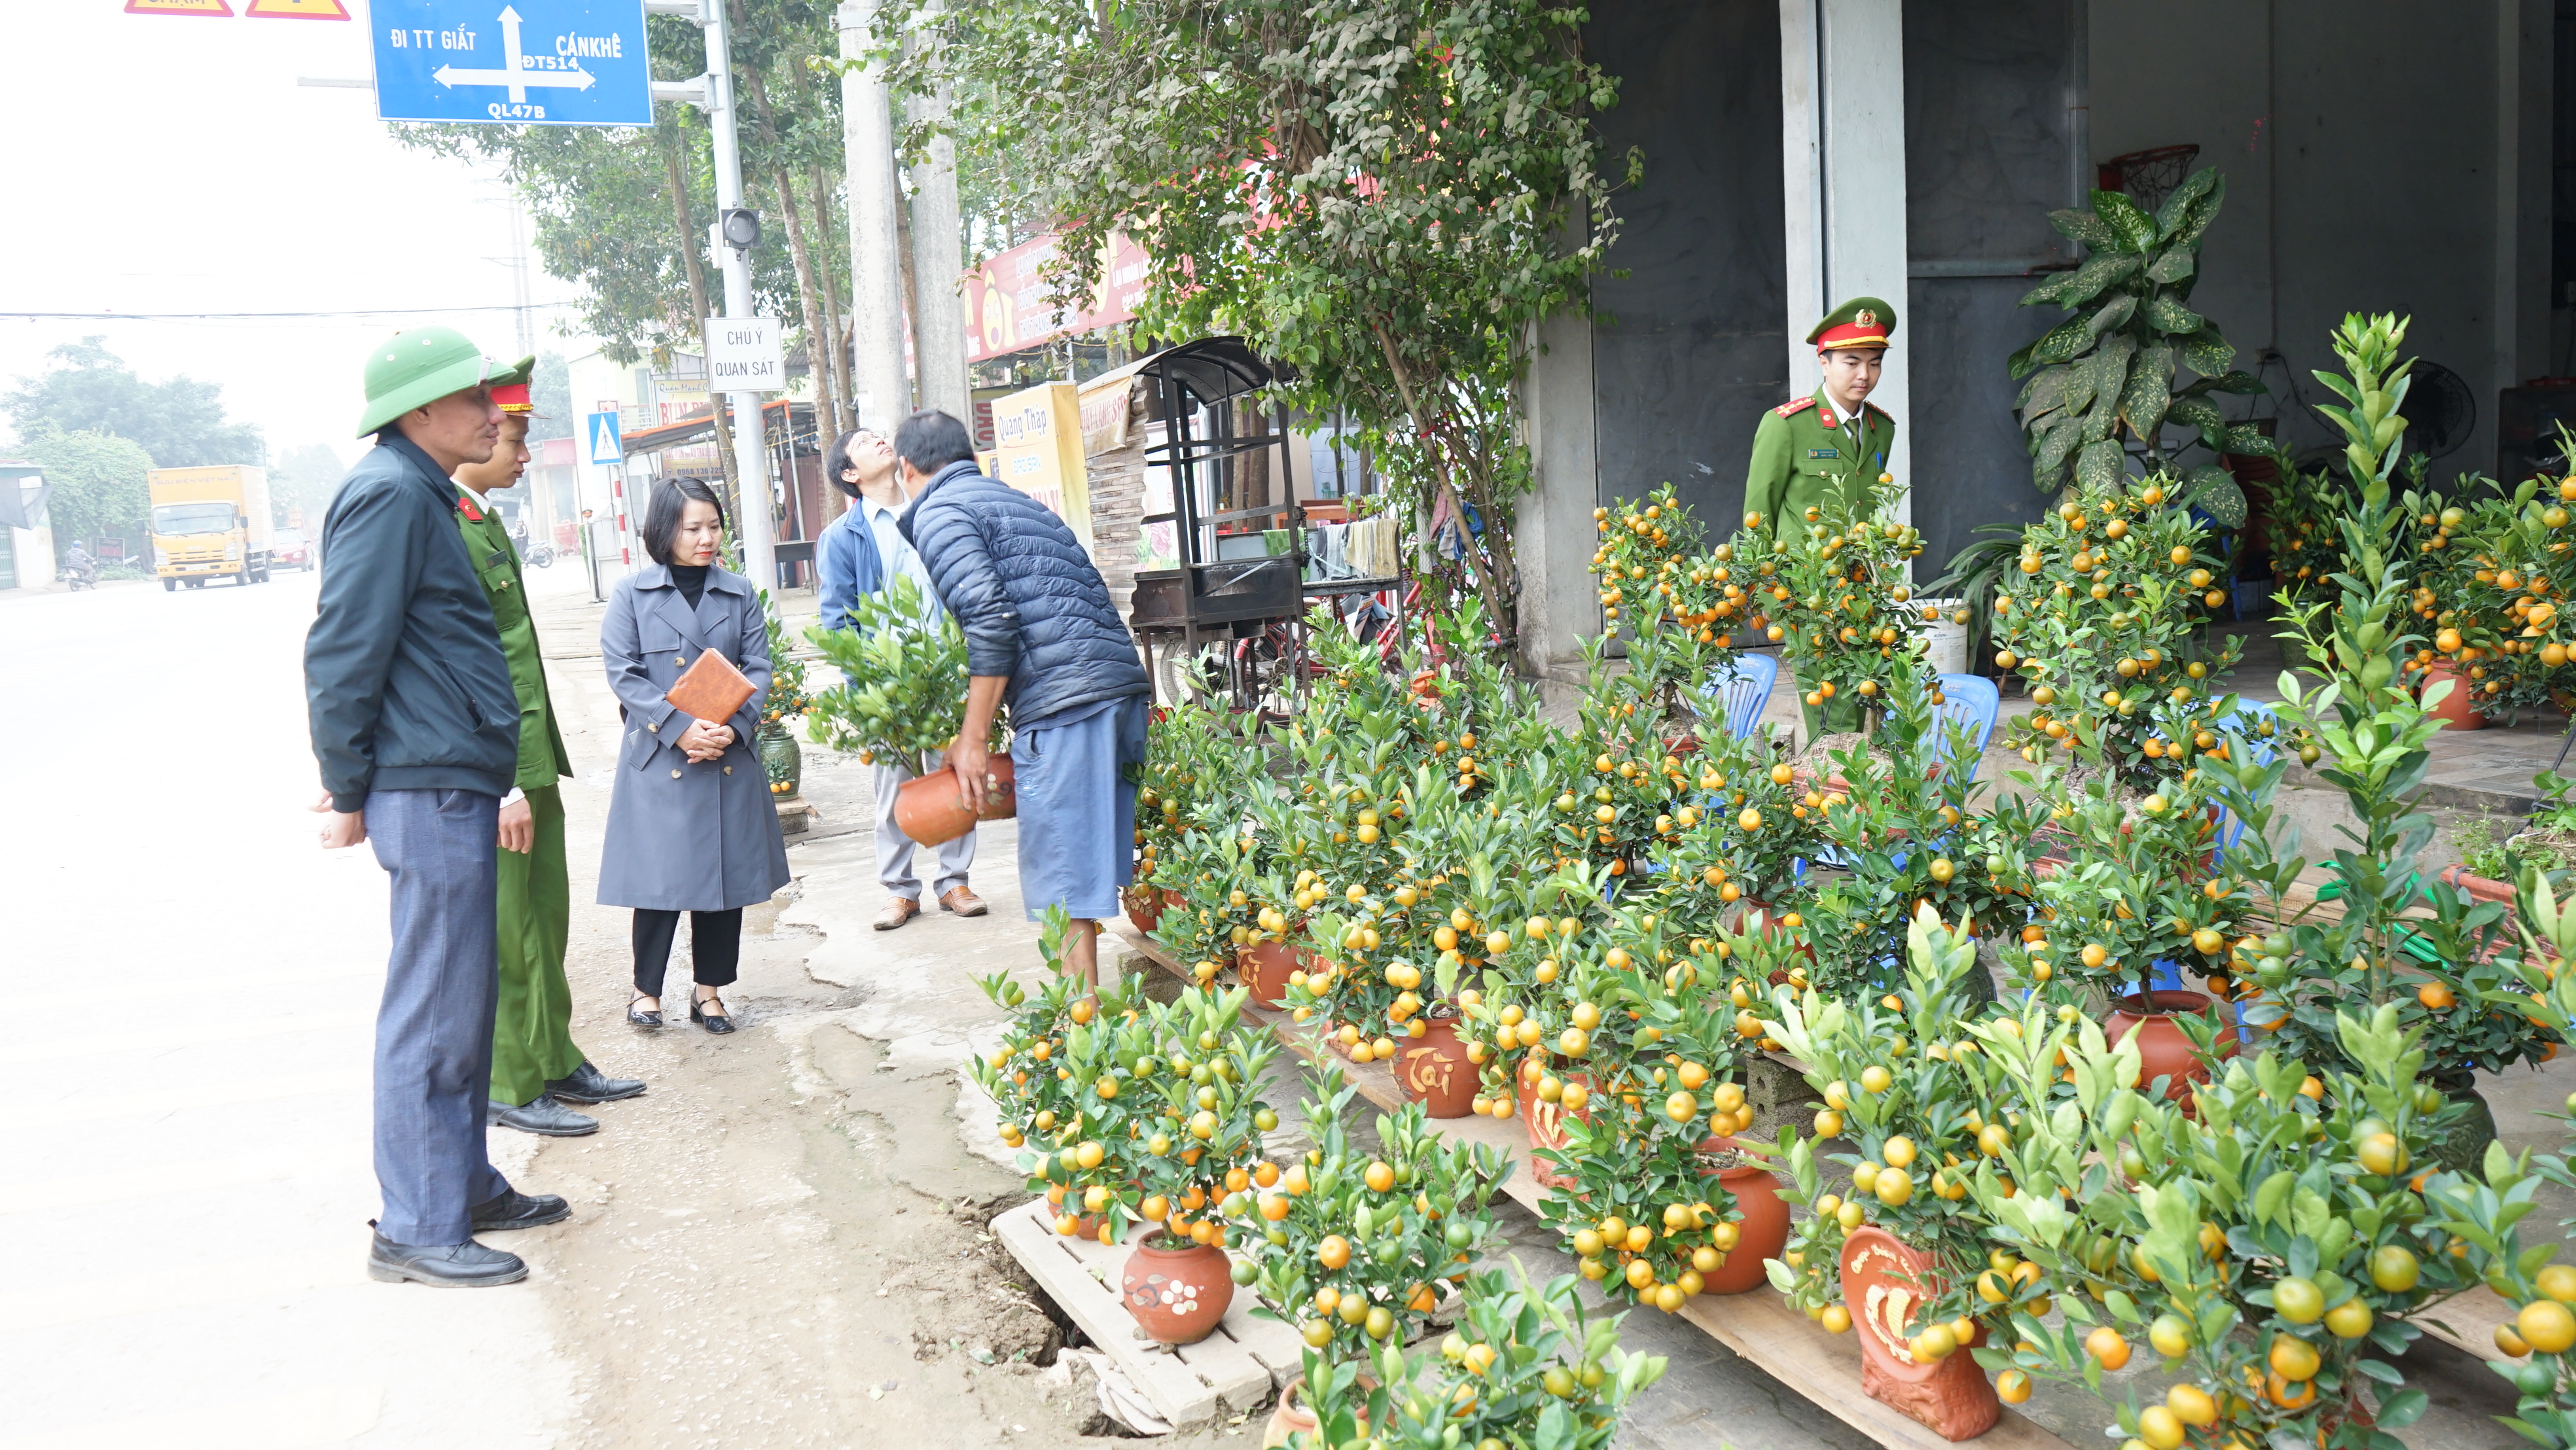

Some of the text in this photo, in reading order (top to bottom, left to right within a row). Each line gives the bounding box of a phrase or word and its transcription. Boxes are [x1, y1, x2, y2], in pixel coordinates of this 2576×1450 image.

[391, 23, 476, 50] ĐI TT GIẮT
[522, 55, 579, 70] ĐT514
[488, 103, 545, 119] QL47B
[727, 327, 762, 345] CHÚ Ý
[715, 357, 774, 376] QUAN SÁT
[659, 383, 679, 393] Quán
[681, 383, 701, 394] Mạnh
[998, 414, 1023, 442] Quang
[1024, 404, 1046, 436] Thập
[1406, 1047, 1456, 1097] Tài
